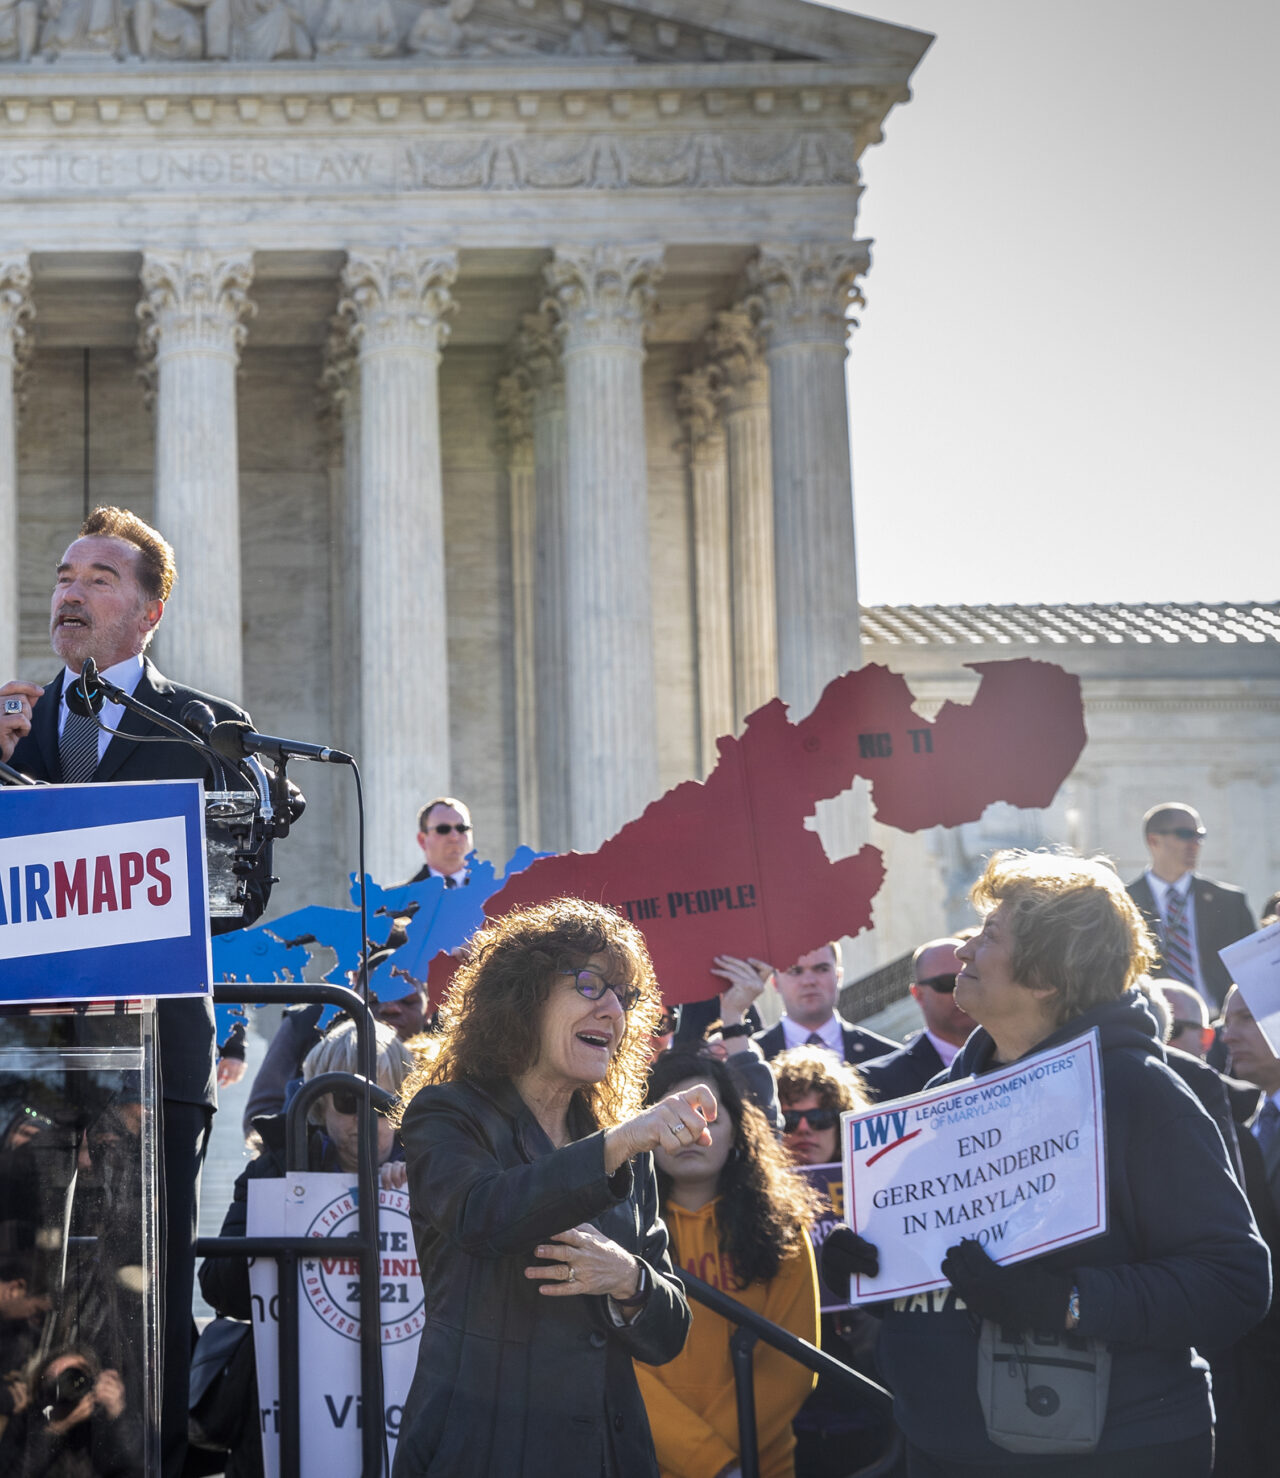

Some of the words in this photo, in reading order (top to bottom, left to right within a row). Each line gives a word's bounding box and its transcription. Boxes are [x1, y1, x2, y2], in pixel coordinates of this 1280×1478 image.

[136, 151, 276, 185] UNDER
[292, 150, 374, 184] LAW
[622, 897, 662, 922] THE
[666, 884, 757, 919] PEOPLE!
[915, 1096, 962, 1121] LEAGUE
[964, 1093, 980, 1107] OF
[980, 1075, 1028, 1102] WOMEN
[929, 1116, 947, 1131] OF
[946, 1095, 1012, 1127] MARYLAND
[853, 1109, 909, 1152] LWV
[957, 1126, 1003, 1159] END
[872, 1129, 1080, 1210] GERRYMANDERING
[322, 1199, 353, 1227] FAIR
[902, 1211, 928, 1236] IN
[934, 1171, 1056, 1230] MARYLAND
[321, 1257, 422, 1277] VIRINI
[346, 1282, 409, 1303] 221
